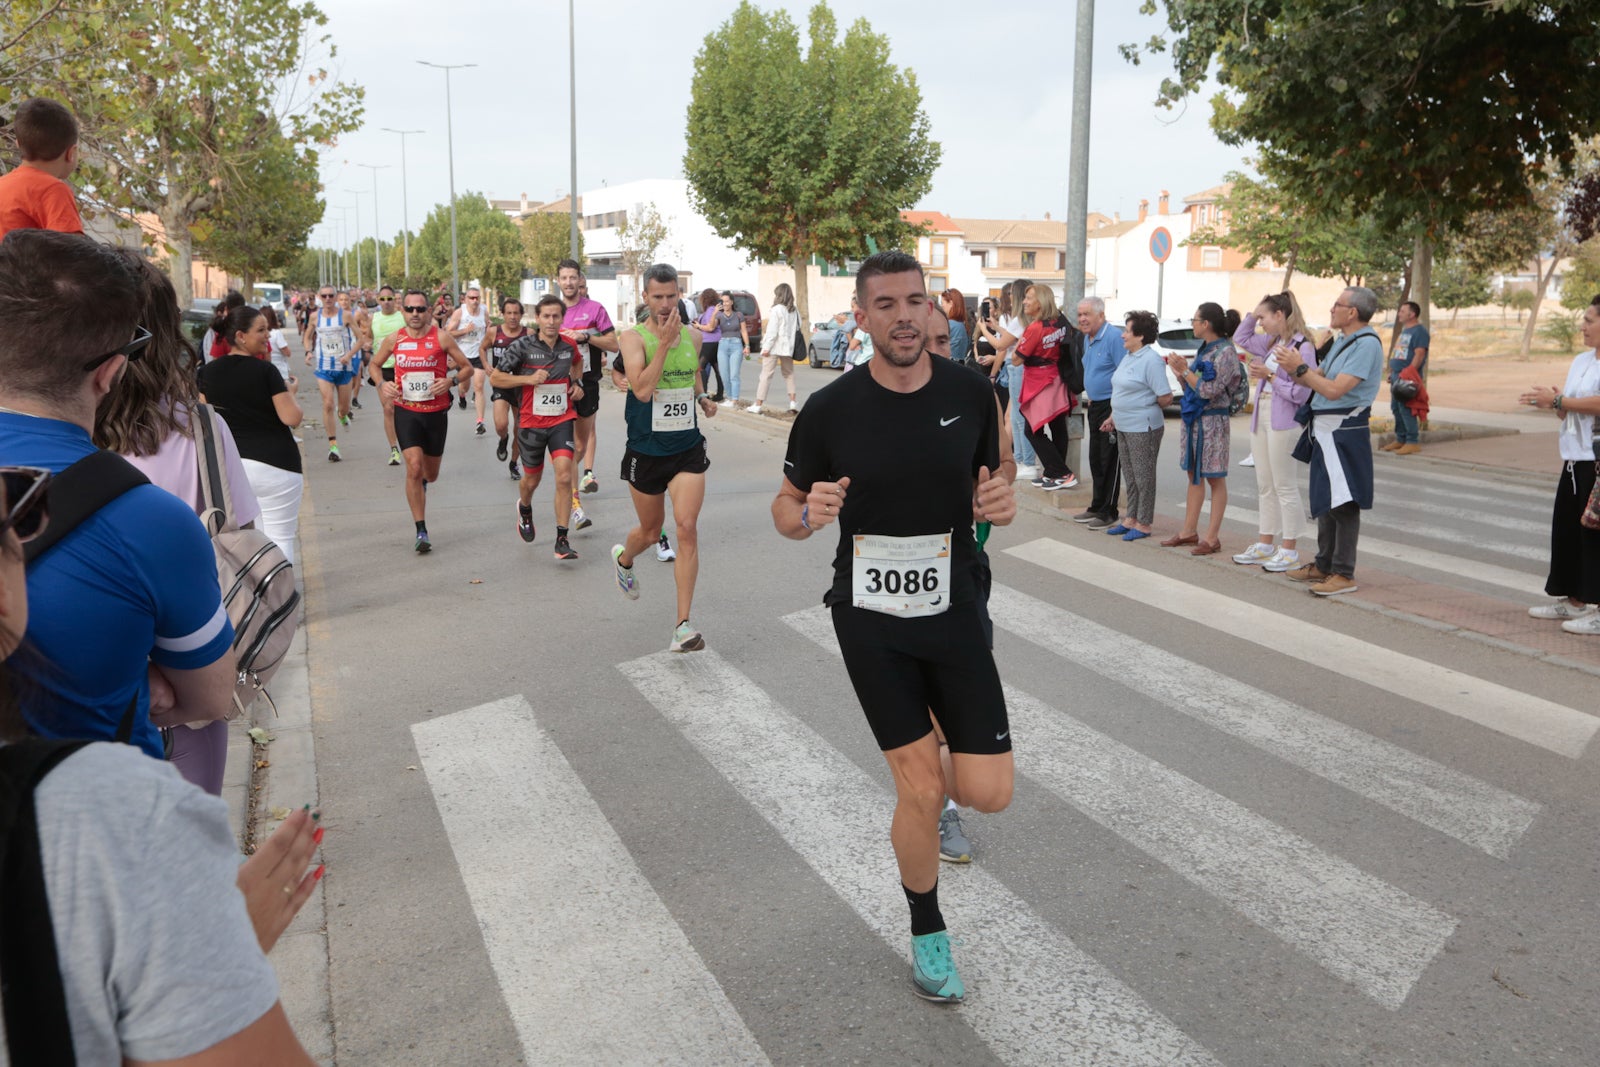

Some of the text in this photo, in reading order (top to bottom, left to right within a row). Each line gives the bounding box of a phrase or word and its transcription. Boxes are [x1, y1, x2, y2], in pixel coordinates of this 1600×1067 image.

[537, 280, 544, 289] P
[326, 343, 339, 351] 141
[396, 353, 438, 369] Polisalud
[541, 394, 562, 405] 249
[663, 402, 688, 417] 259
[865, 567, 939, 595] 3086
